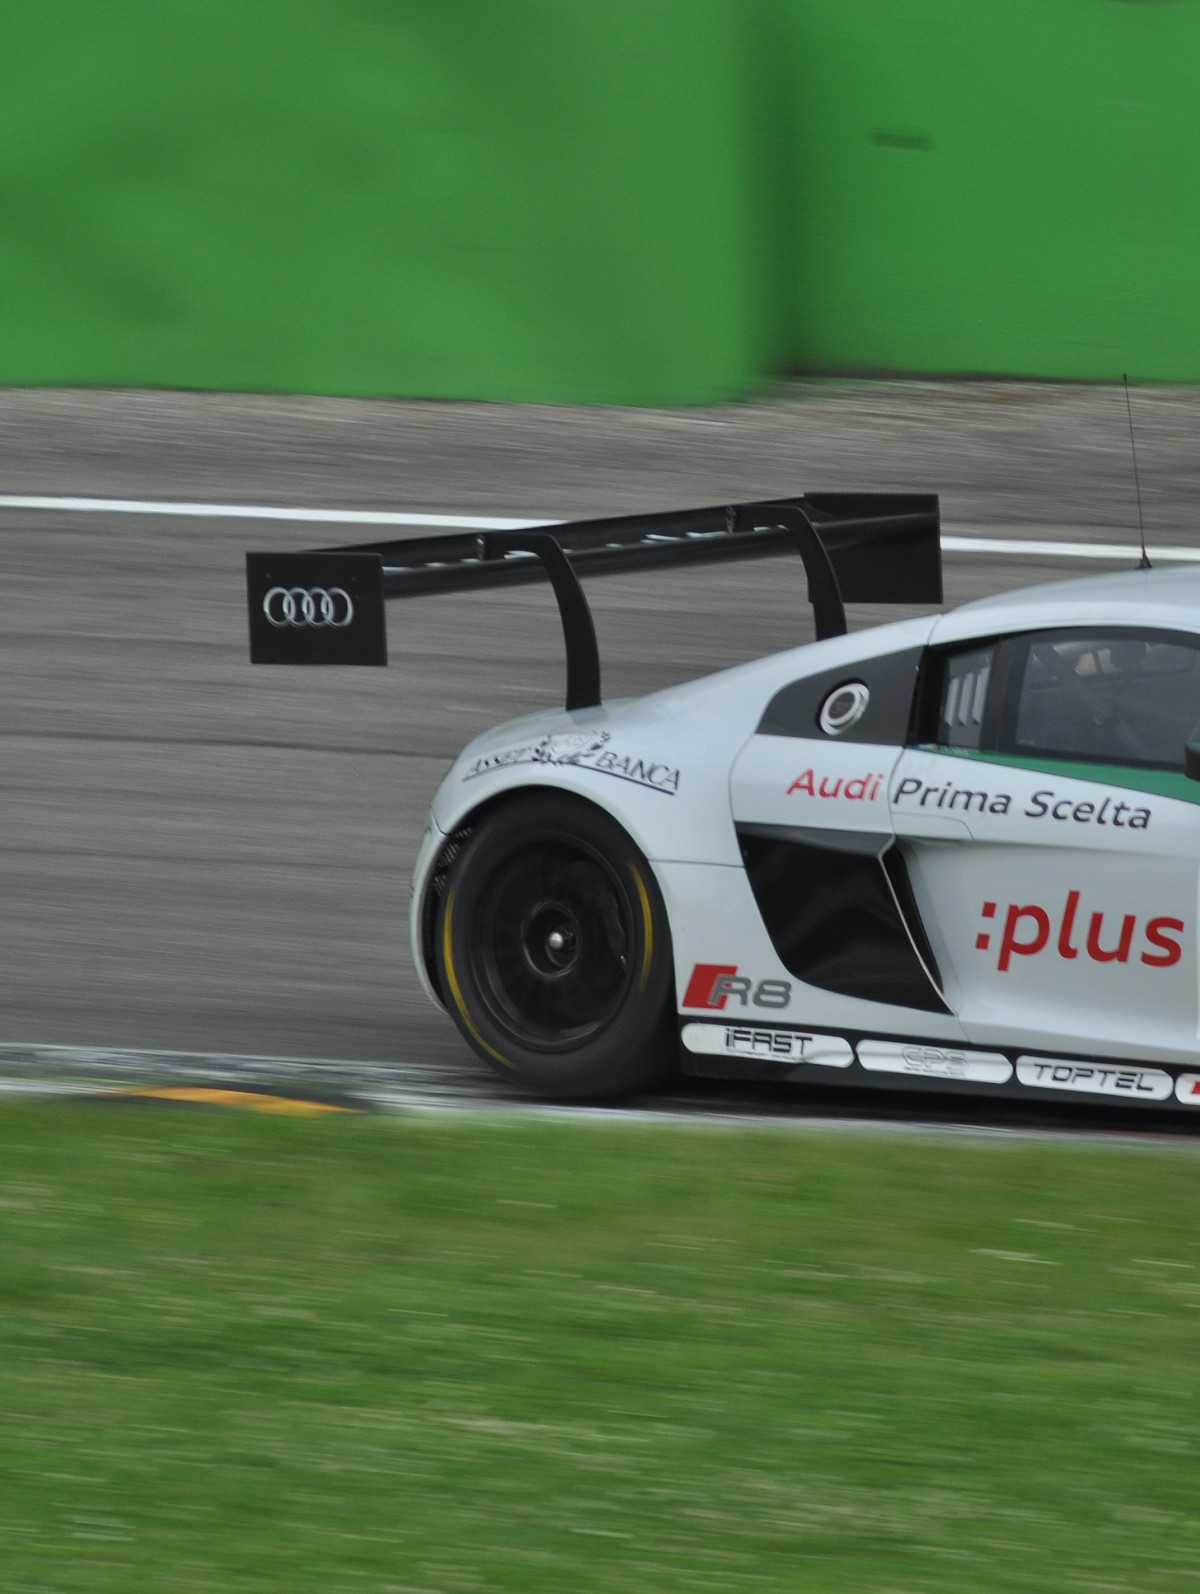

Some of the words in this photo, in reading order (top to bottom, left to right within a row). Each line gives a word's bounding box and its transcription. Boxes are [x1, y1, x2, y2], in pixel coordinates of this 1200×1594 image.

[596, 751, 681, 791] BANCA
[786, 768, 884, 801] Audi
[893, 777, 1012, 816] Prima
[1025, 790, 1152, 830] Scelta
[707, 973, 792, 1009] R8
[1033, 1063, 1154, 1092] TOPTEL
